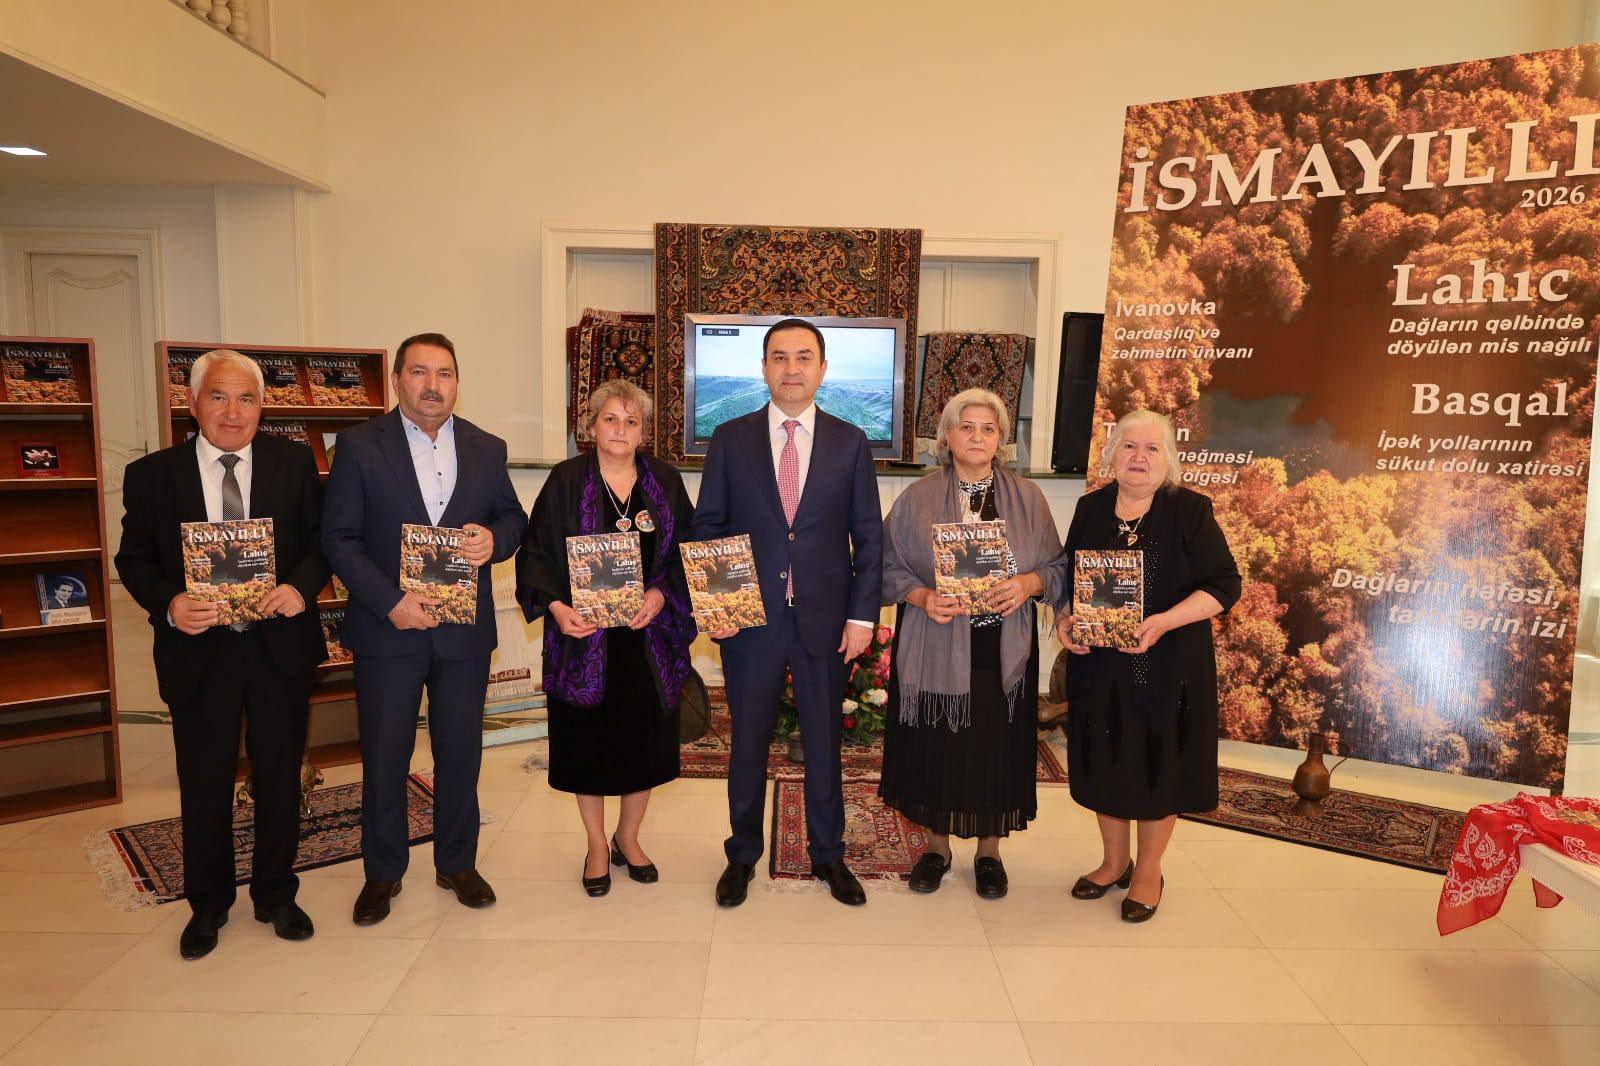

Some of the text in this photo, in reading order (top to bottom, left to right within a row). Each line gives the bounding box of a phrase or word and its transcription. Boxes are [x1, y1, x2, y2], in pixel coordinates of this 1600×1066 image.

[1124, 113, 1600, 213] İSMAYILLI
[1520, 185, 1586, 208] 2026
[1391, 258, 1570, 306] Lahıc
[1113, 326, 1221, 342] Qardaşlıq və
[1388, 314, 1585, 336] Dağların qəlbində
[1110, 346, 1254, 360] zəhmətin ünvanı
[1387, 336, 1592, 359] döyülən mis nağılı
[1411, 382, 1569, 427] Basqal
[1377, 430, 1533, 453] İpək yollarının
[1180, 468, 1240, 486] ölgəsi
[1375, 456, 1585, 477] sükut dolu xatirəsi
[1331, 567, 1560, 610] Dağların nəfəsi,
[1530, 616, 1569, 639] izi
